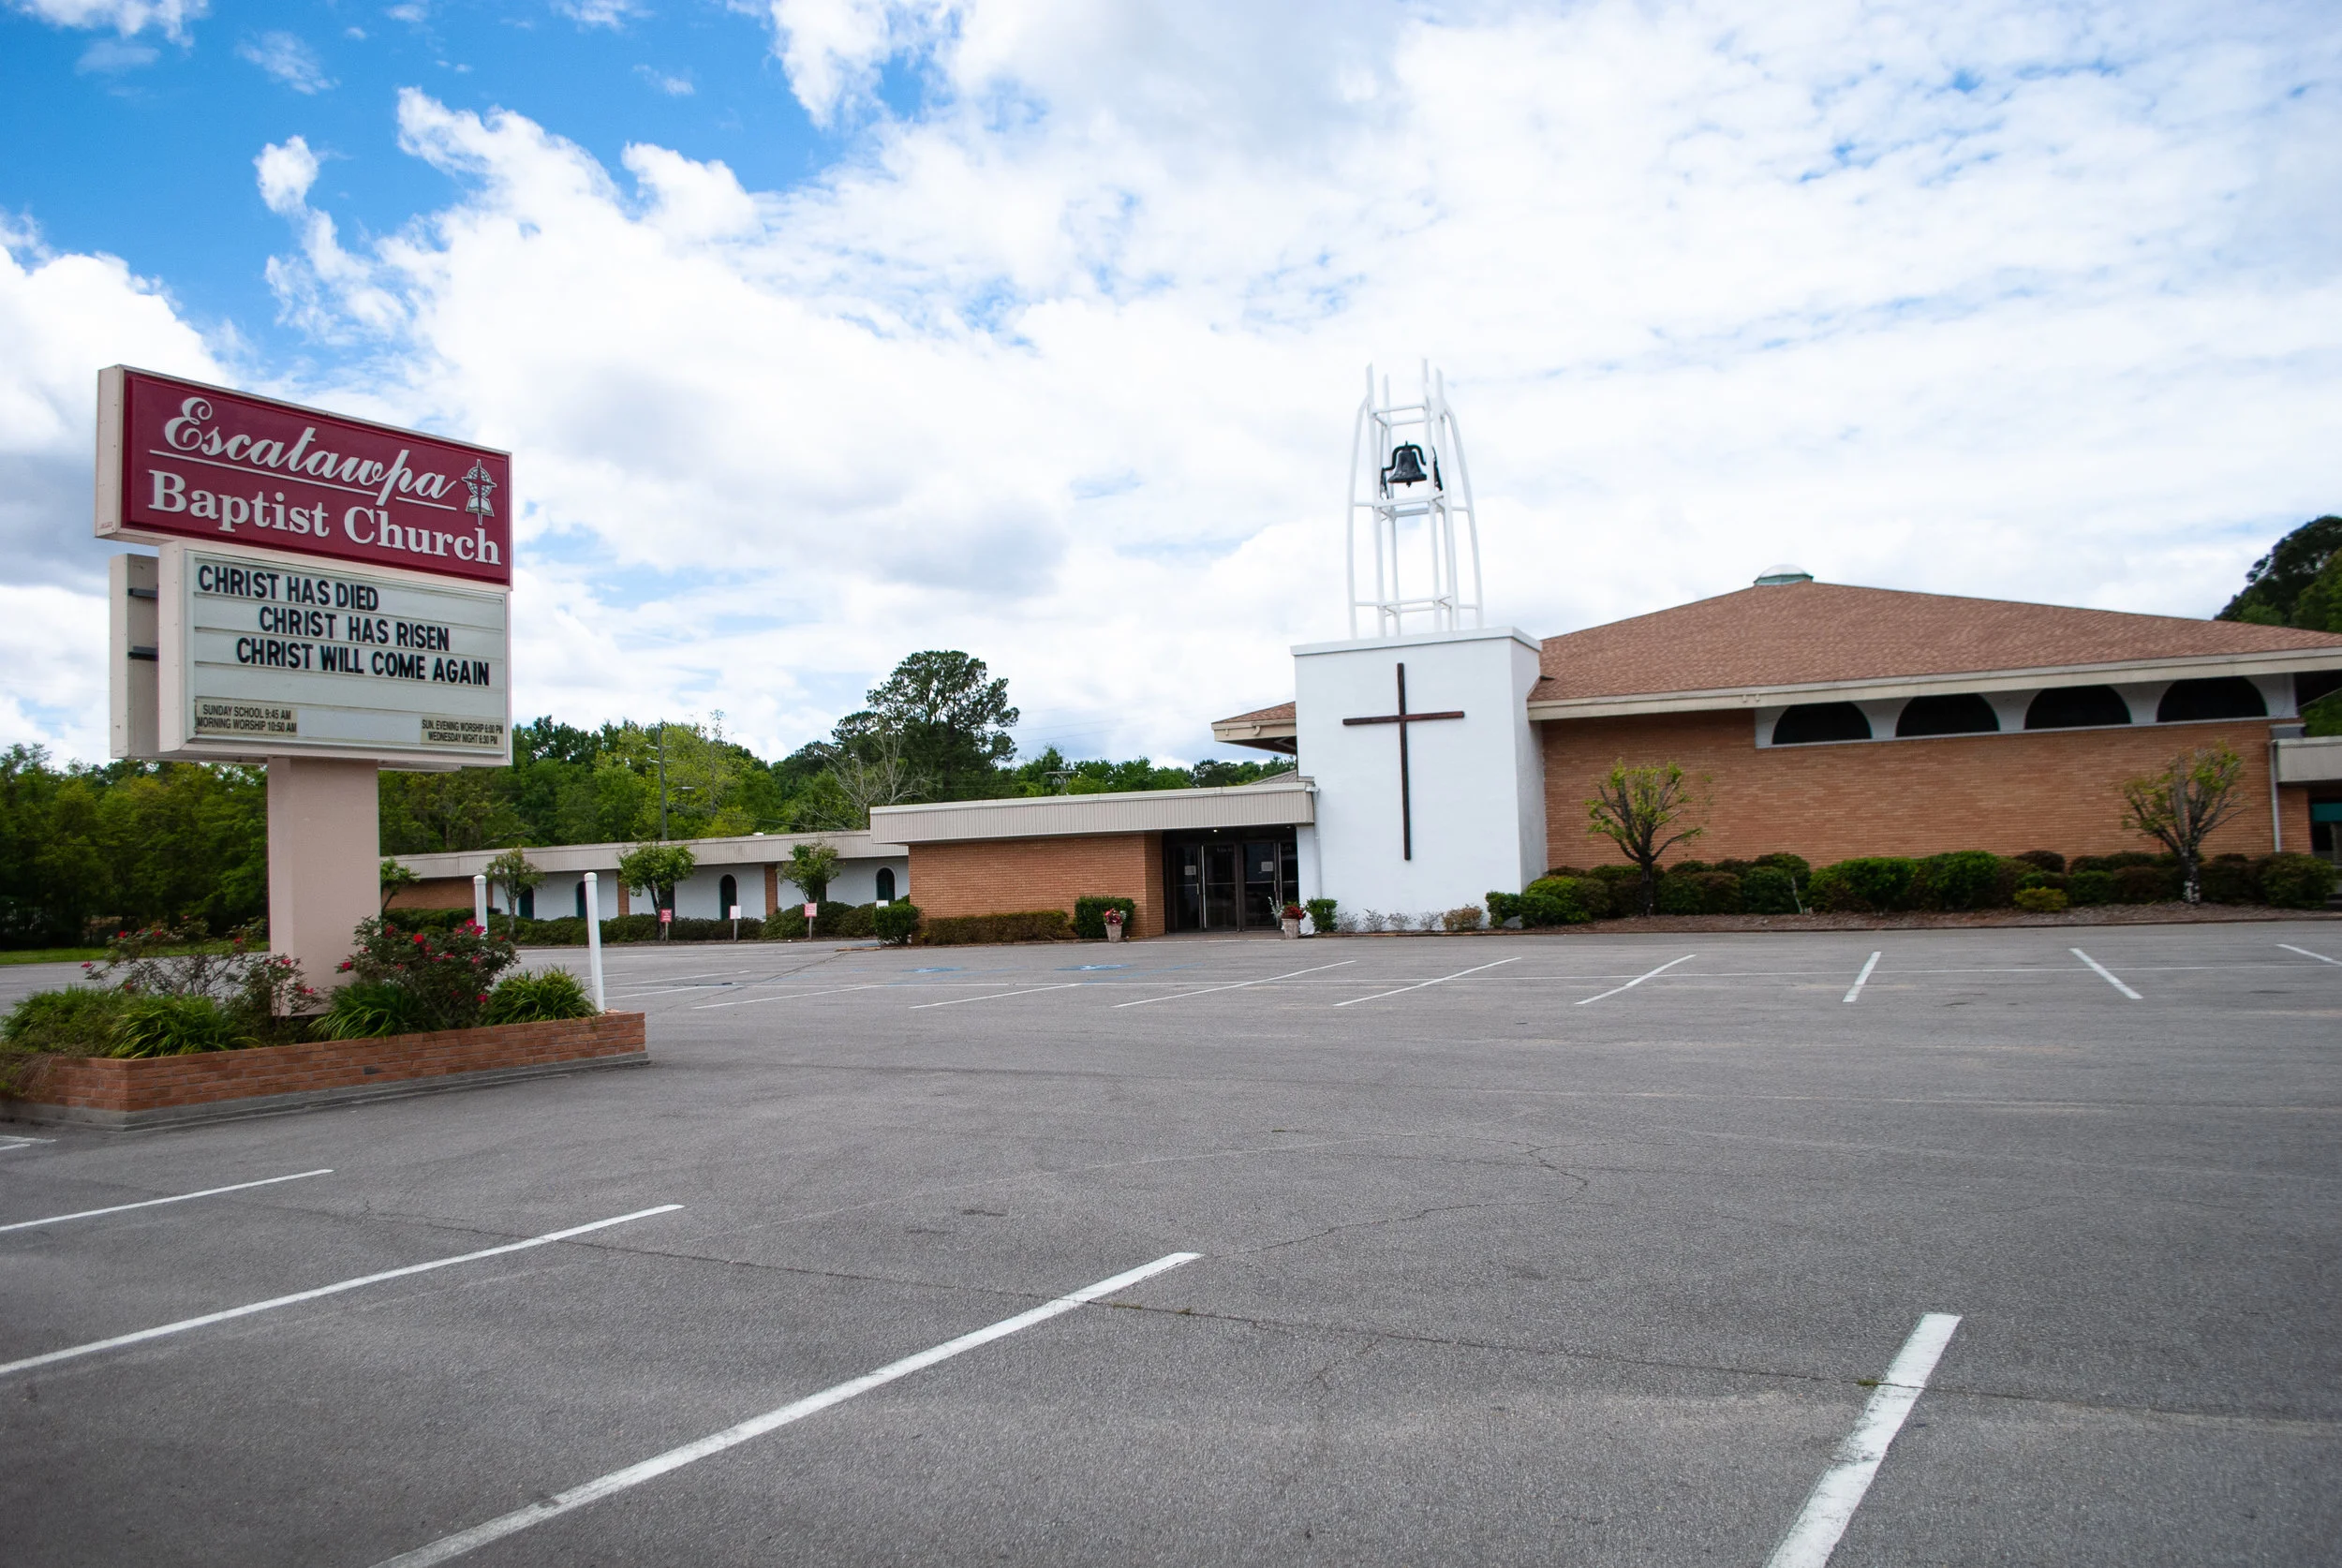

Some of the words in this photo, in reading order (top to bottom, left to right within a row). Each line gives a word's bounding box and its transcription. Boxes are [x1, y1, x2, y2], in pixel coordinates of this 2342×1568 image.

[164, 396, 457, 506] Escatawpa
[148, 469, 330, 537] Baptist
[344, 506, 501, 565] Church
[199, 565, 279, 599] CHRIST
[287, 576, 331, 606] HAS
[336, 583, 379, 612] DIED
[259, 606, 337, 639] CHRIST
[348, 615, 390, 644] HAS
[396, 622, 450, 652] RISEN
[236, 638, 314, 670] CHRIST
[319, 644, 364, 673] WILL
[372, 651, 425, 680] COME
[433, 658, 490, 686] AGAIN
[197, 717, 231, 729] MORNING
[232, 719, 266, 731] WORSHIP
[286, 723, 297, 732] AM
[202, 704, 232, 716] SUNDAY
[234, 706, 264, 718] SCHOOL
[265, 709, 279, 719] 9:45
[280, 710, 291, 720] AM
[436, 720, 459, 731] EVENING
[460, 722, 484, 732] WORSHIP
[496, 725, 503, 734] PM
[428, 732, 461, 742] WEDNESDAY
[462, 733, 478, 744] NIGHT
[490, 735, 497, 745] PM
